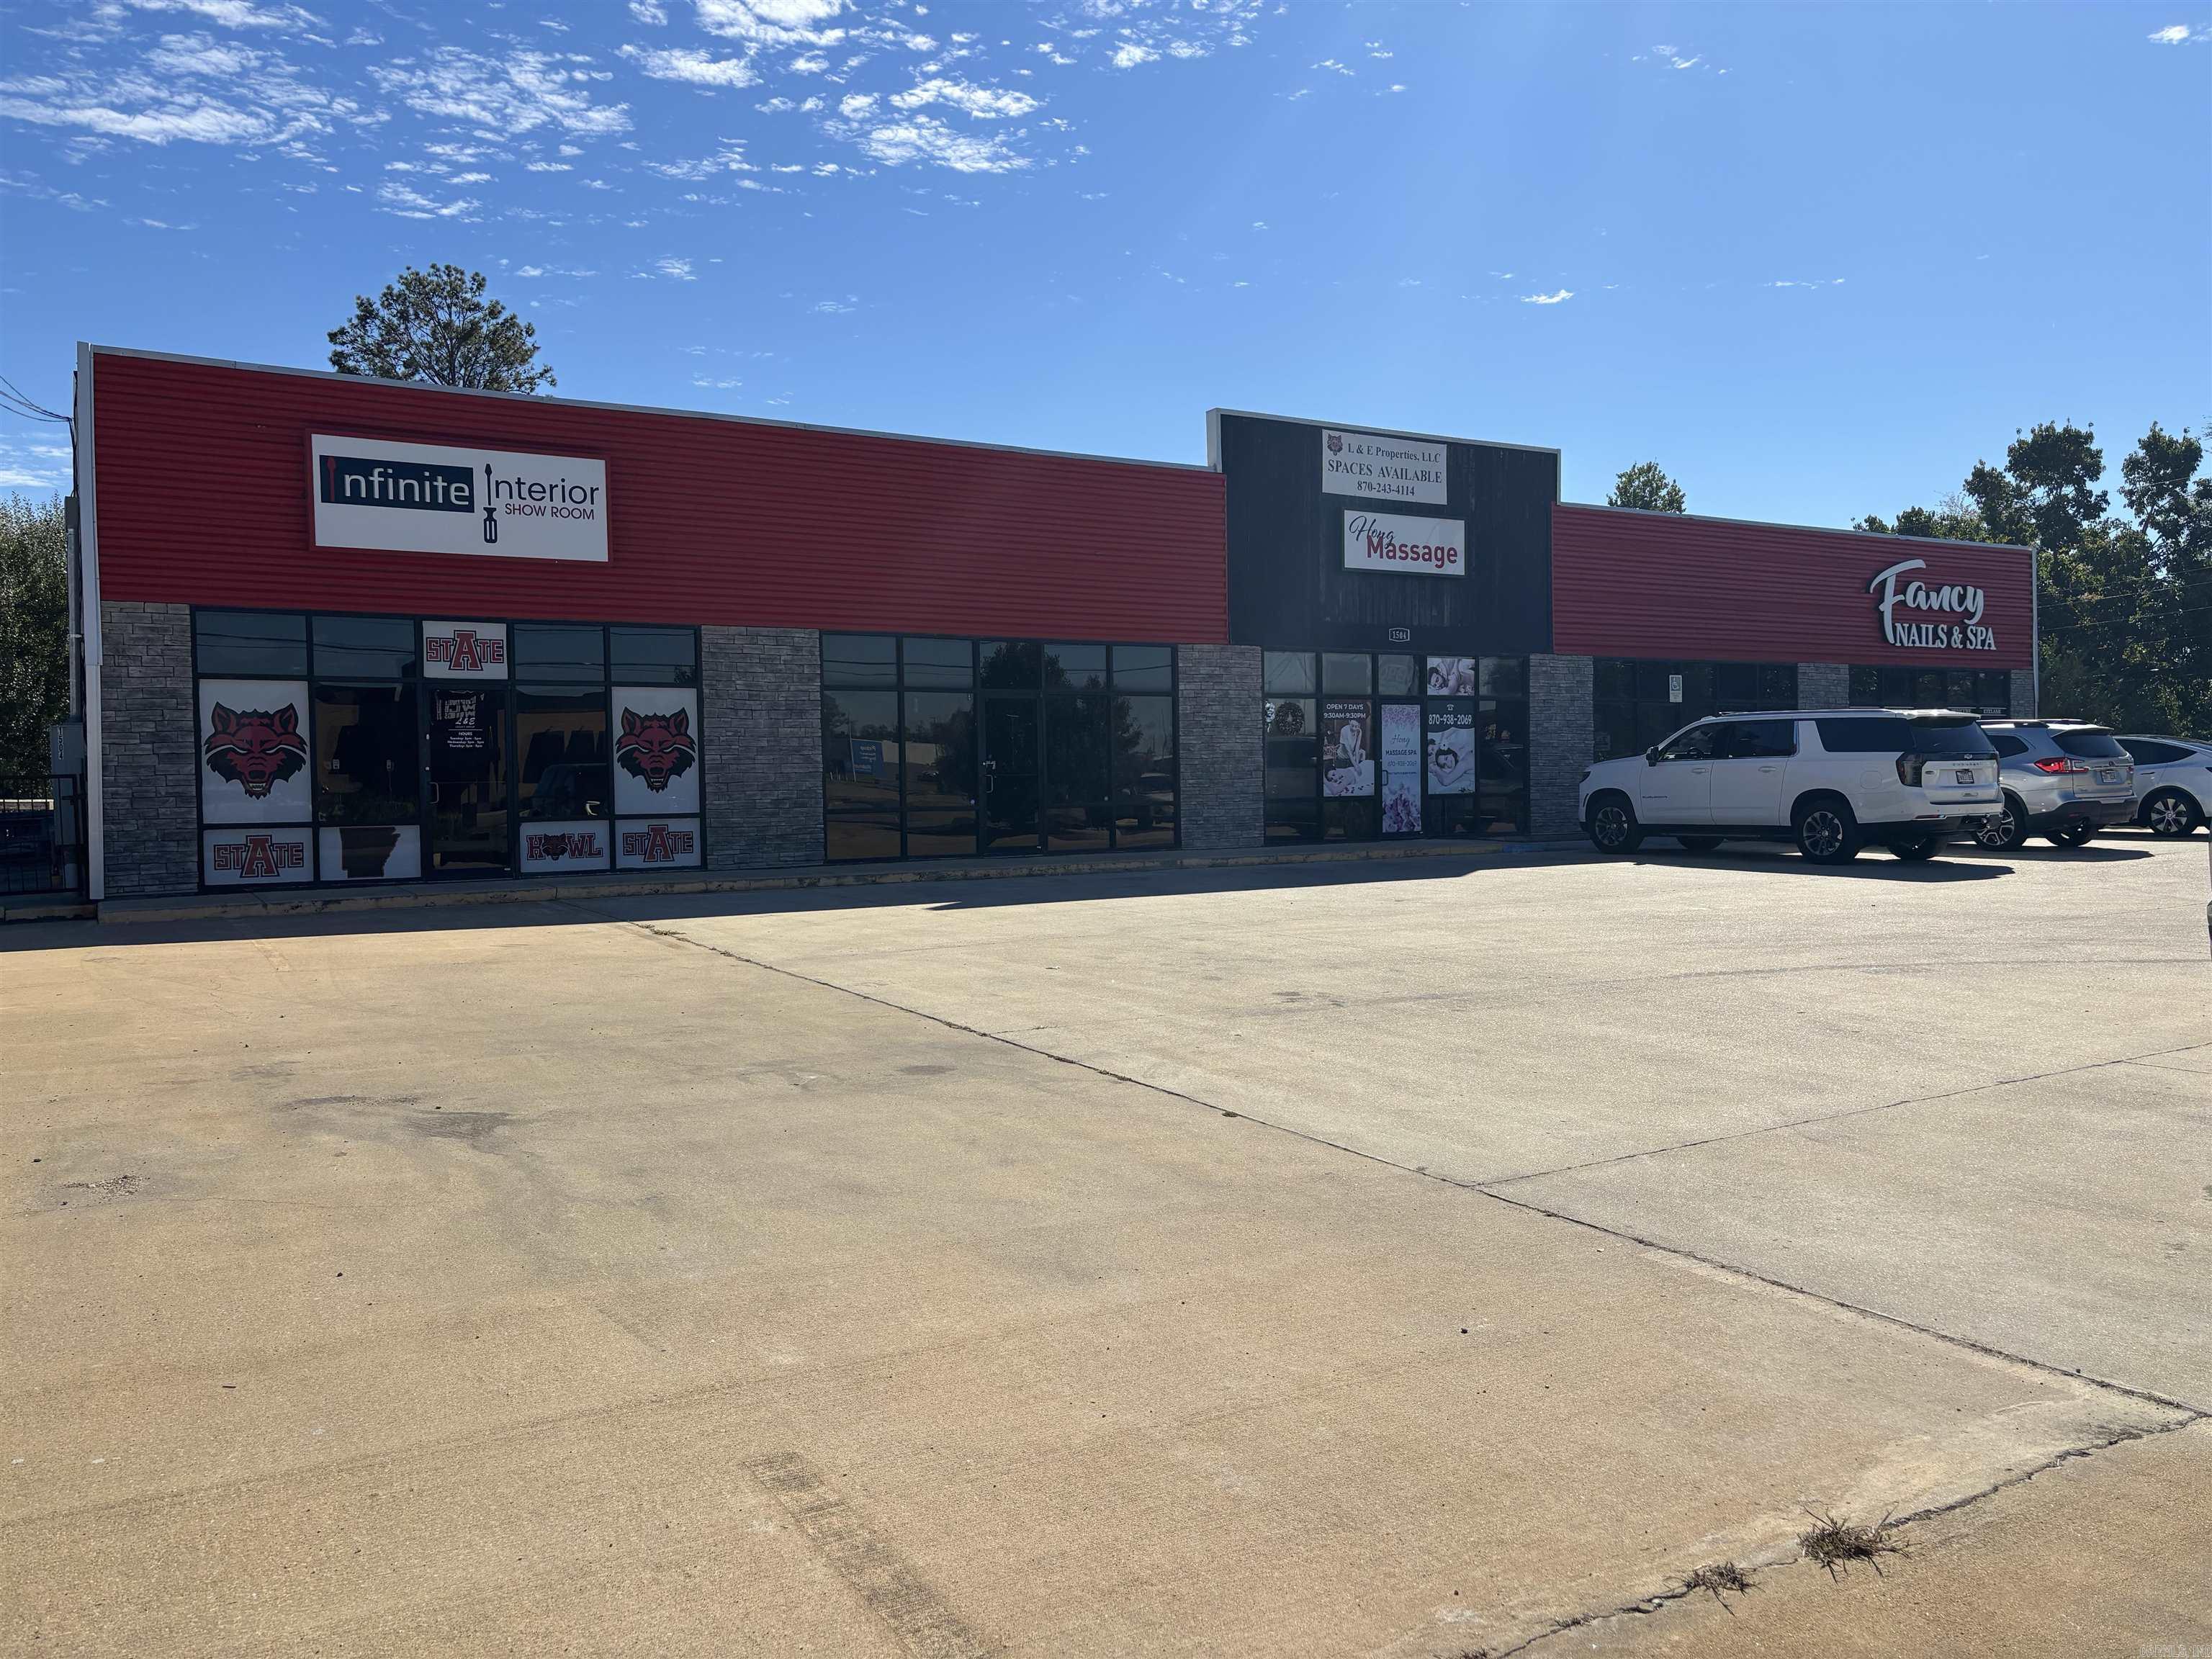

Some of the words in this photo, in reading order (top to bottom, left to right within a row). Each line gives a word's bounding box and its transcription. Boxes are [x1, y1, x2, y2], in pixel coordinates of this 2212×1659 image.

[1348, 444, 1354, 454] L
[1357, 445, 1364, 454] &
[1367, 446, 1373, 455] E
[1376, 447, 1419, 462] Properties,
[1422, 452, 1441, 463] LLC
[1328, 459, 1373, 477] SPACES
[1377, 467, 1442, 483] AVAILABLE
[1357, 481, 1415, 496] 870-243-4114
[504, 503, 547, 517] SHOW
[551, 506, 595, 520] ROOM
[1349, 516, 1396, 549] Hong
[1367, 534, 1458, 568] Massage
[1870, 559, 1984, 644] Fancy
[426, 629, 505, 671] STATE
[1894, 623, 1947, 648] NAILS
[1951, 626, 1963, 649] &
[1966, 625, 1997, 650] SPA
[1429, 714, 1472, 724] 870-938-2069
[213, 835, 305, 878] STATE
[622, 824, 693, 863] STATE
